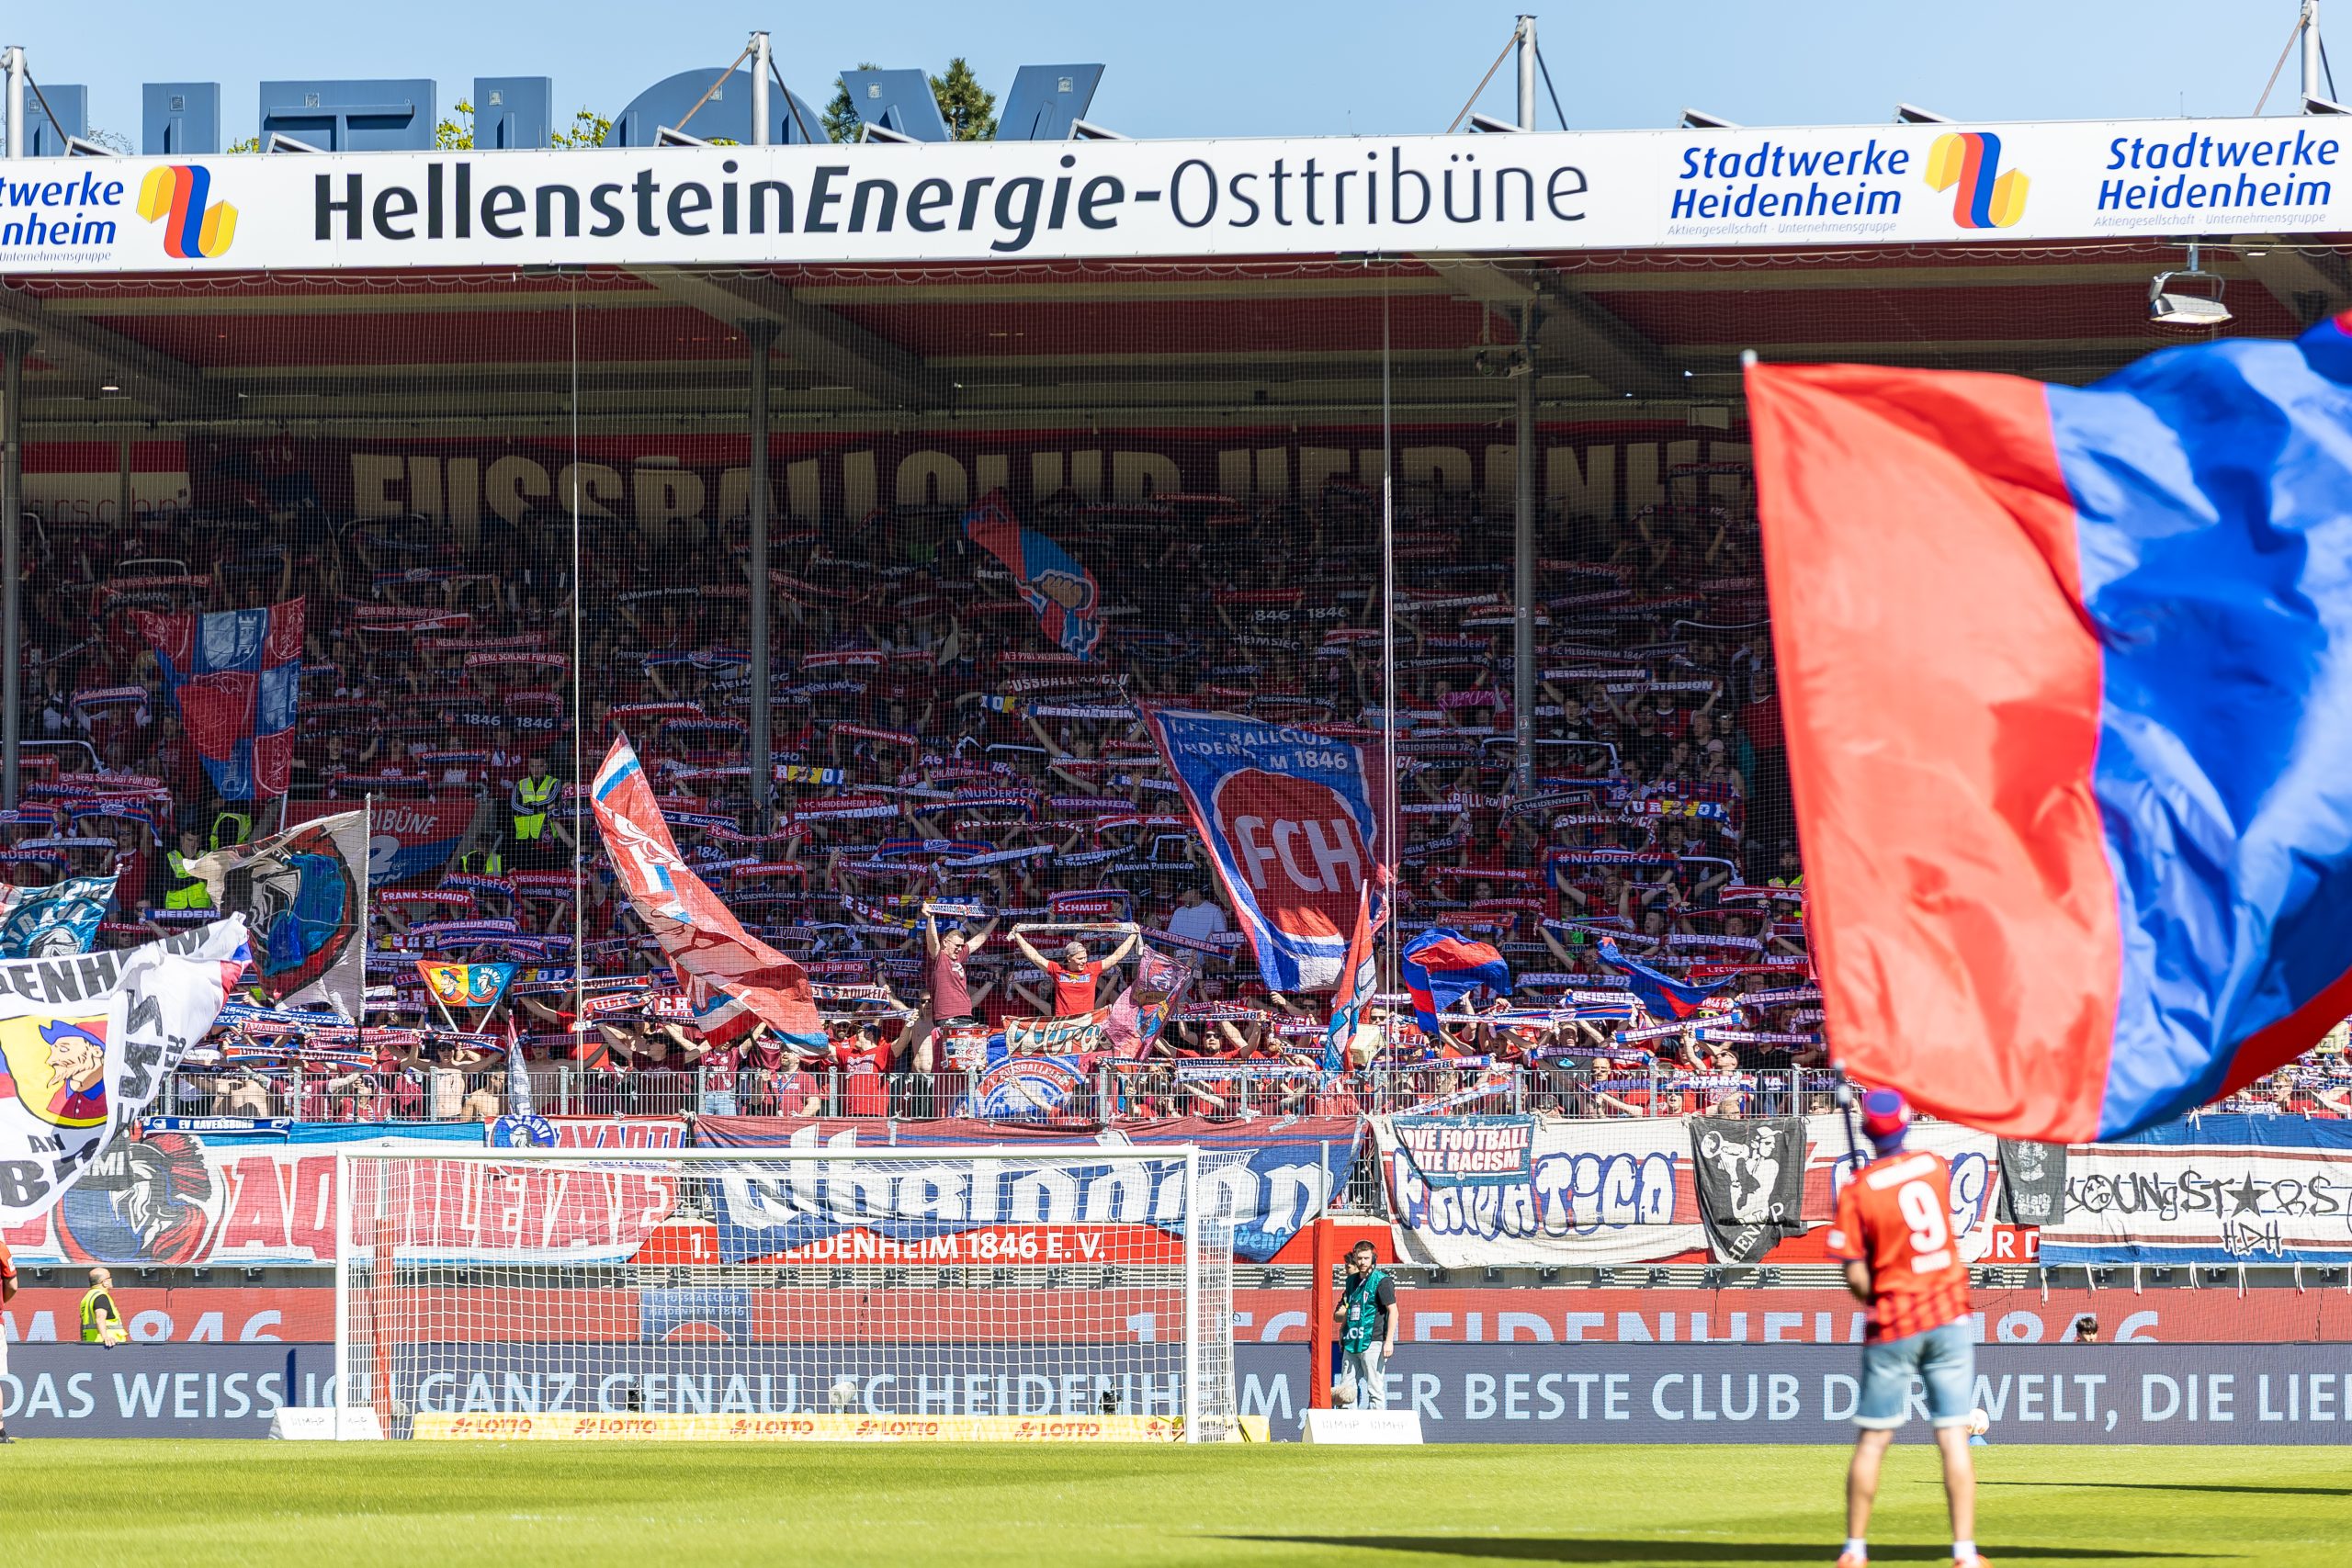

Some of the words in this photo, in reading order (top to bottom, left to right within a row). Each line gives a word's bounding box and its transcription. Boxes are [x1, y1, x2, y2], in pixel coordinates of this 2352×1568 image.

[2107, 130, 2339, 170] Stadtwerke
[1679, 139, 1909, 179] Stadtwerke
[2098, 172, 2331, 209] Heidenheim
[314, 146, 1589, 253] HellensteinEnergie-Osttribüne
[1671, 182, 1902, 220] Heidenheim
[1668, 222, 1768, 236] Aktiengesellschaft
[1777, 220, 1896, 235] Unternehmensgruppe
[2094, 214, 2197, 229] Aktiengesellschaft
[2205, 212, 2326, 226] Unternehmensgruppe
[2, 212, 116, 245] nheim
[630, 588, 663, 599] MARVIN
[1437, 593, 1499, 608] STADION
[1565, 646, 1621, 659] HEIDENHEIM
[1409, 656, 1468, 667] HEIDENHEIM
[1544, 669, 1646, 680] HEIDENHEIM
[1651, 681, 1714, 692] STADION
[620, 704, 631, 713] FC
[633, 702, 685, 712] HEIDENHEIM
[463, 713, 501, 727] 1846
[515, 716, 552, 729] 1846
[1397, 743, 1458, 752] HEIDENHEIM
[1294, 750, 1350, 770] 1846
[958, 786, 1038, 801] #NURDERFCH
[817, 799, 868, 808] HEIDENHEIM
[1052, 796, 1136, 810] HEIDENHEIM
[1526, 794, 1582, 810] HEIDENHEIM
[1426, 837, 1453, 851] 1846
[1235, 814, 1362, 893] FCH
[1559, 853, 1661, 865] #NURDERFCH
[746, 863, 793, 874] HEIDENHEIM
[839, 860, 849, 868] FC
[851, 861, 908, 871] HEIDENHEIM
[909, 863, 928, 874] 1846
[1114, 863, 1150, 873] MARVIN
[1151, 862, 1194, 872] PIERINGER
[1455, 868, 1506, 877] HEIDENHEIM
[1507, 870, 1527, 879] 1846
[443, 874, 515, 894] #NURDERFCH
[516, 874, 568, 885] HEIDENHEIM
[381, 891, 418, 902] FRANK
[421, 890, 470, 903] SCHMIDT
[1057, 902, 1109, 912] SCHMIDT
[844, 963, 864, 972] DICH
[1704, 1028, 1812, 1043] HEIDENHEIM
[178, 1118, 190, 1130] EV
[557, 1124, 682, 1149] AVANTI
[1404, 1130, 1436, 1150] OVE
[1442, 1128, 1529, 1151] FOOTBALL
[1413, 1149, 1444, 1171] ATE
[1447, 1148, 1521, 1172] RACISM
[1898, 1180, 1948, 1253] 9
[690, 1233, 710, 1259] 1.
[777, 1232, 958, 1260] EIDENHEIM
[970, 1232, 1038, 1260] 1846
[1046, 1234, 1071, 1259] E.
[1079, 1234, 1107, 1259] V.
[112, 1371, 285, 1419] WEISS
[419, 1371, 577, 1416] GANZ
[598, 1372, 813, 1416] GENAU.
[920, 1372, 1308, 1431] HEIDENHM,
[1351, 1373, 1444, 1421] ER
[1465, 1373, 1630, 1421] BESTE
[1653, 1373, 1801, 1422] CLUB
[1824, 1373, 1928, 1422] DR
[1968, 1373, 2119, 1433] WELT,
[2141, 1373, 2236, 1422] DIE
[2260, 1373, 2352, 1422] LIE
[477, 1417, 533, 1435] LOTTO
[599, 1419, 658, 1435] LOTTO
[754, 1419, 815, 1435] LOTTO
[882, 1420, 939, 1436] LOTTO
[1040, 1422, 1101, 1438] LOTTO
